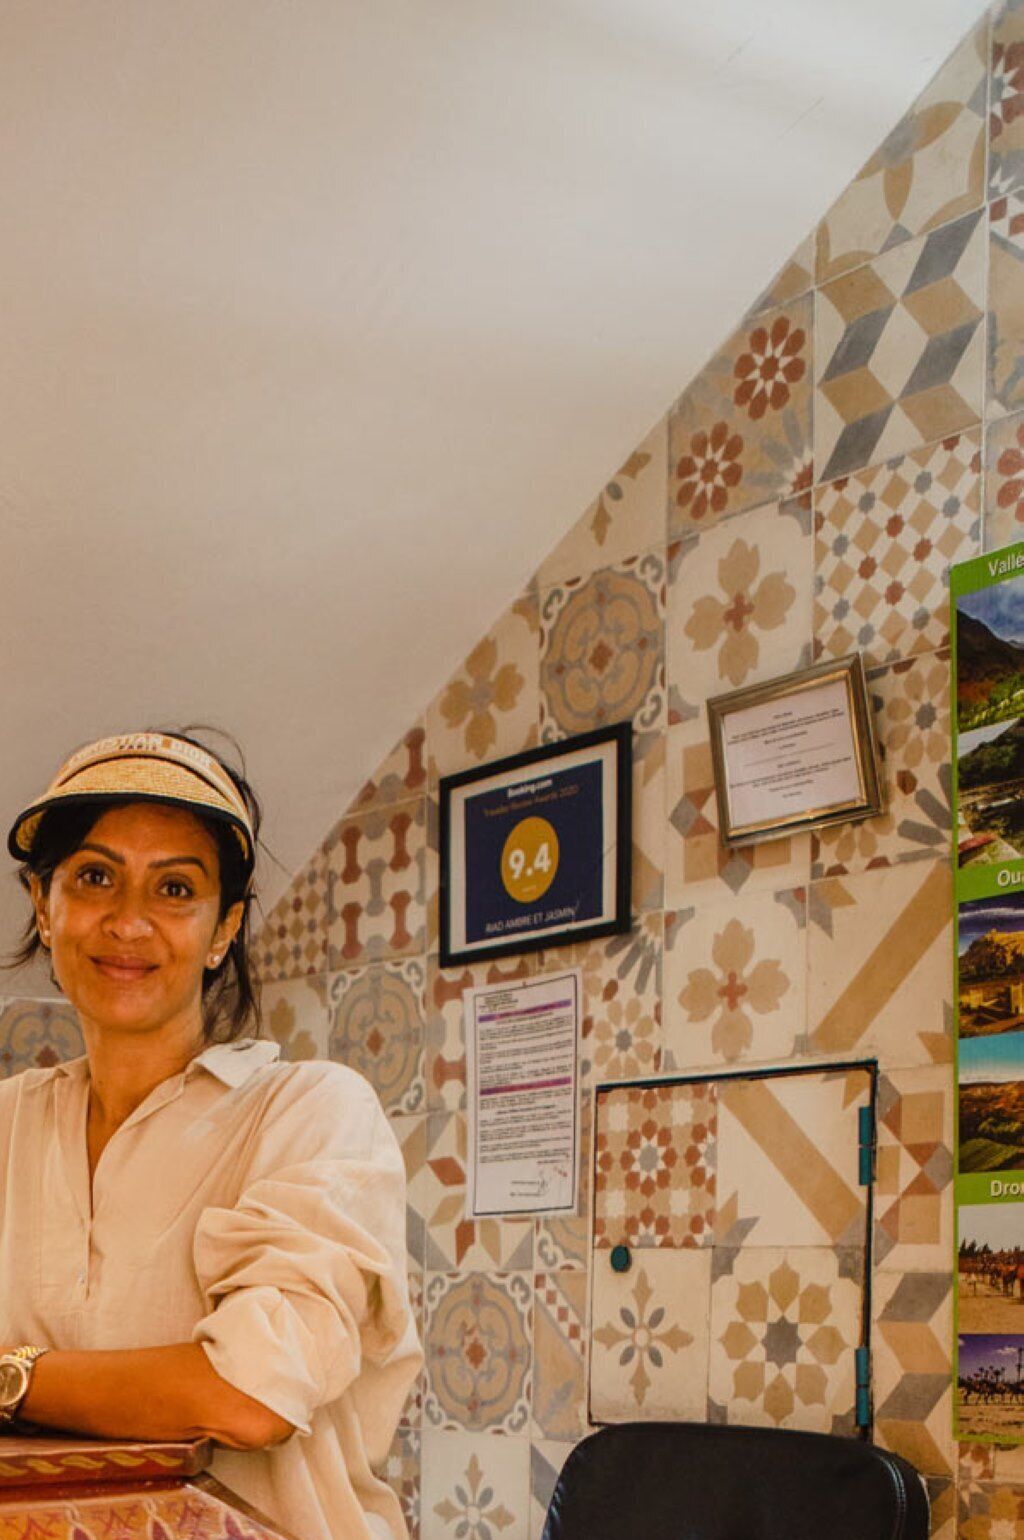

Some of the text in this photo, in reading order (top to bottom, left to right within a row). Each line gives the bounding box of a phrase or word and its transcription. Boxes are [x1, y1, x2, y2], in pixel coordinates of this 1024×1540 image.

[508, 842, 551, 880] 9.4
[997, 869, 1024, 887] Ou
[990, 1180, 1024, 1197] Dro
